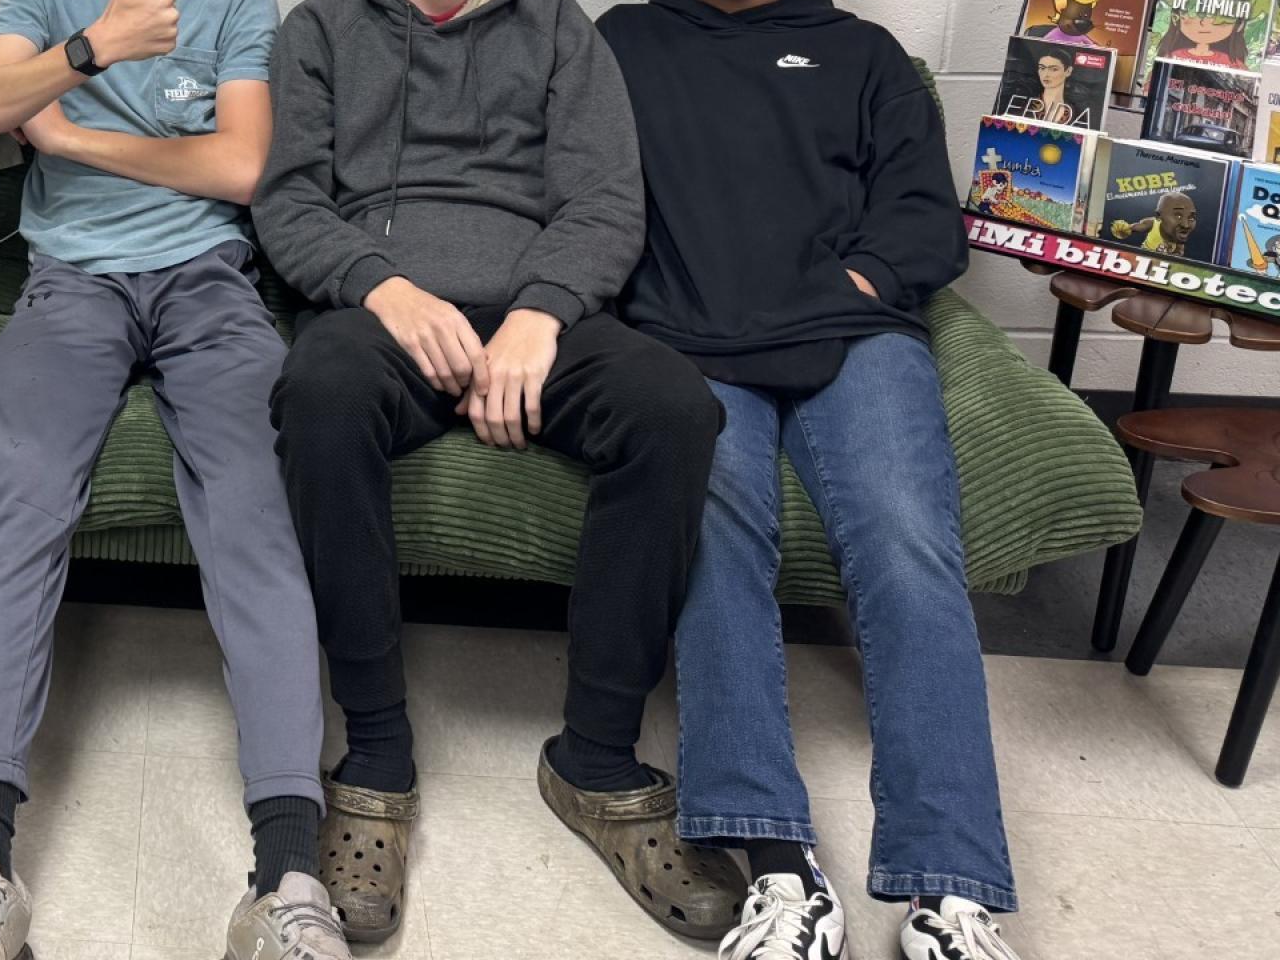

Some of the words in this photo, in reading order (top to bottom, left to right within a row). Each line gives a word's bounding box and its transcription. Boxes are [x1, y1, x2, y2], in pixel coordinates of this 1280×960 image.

[783, 53, 811, 65] NIKE
[1004, 94, 1092, 130] FRIDA
[1135, 148, 1165, 161] Theresa
[1116, 171, 1178, 193] KOBE
[1106, 192, 1114, 201] El
[1114, 189, 1148, 200] nacimiento
[1170, 183, 1197, 194] leyenda
